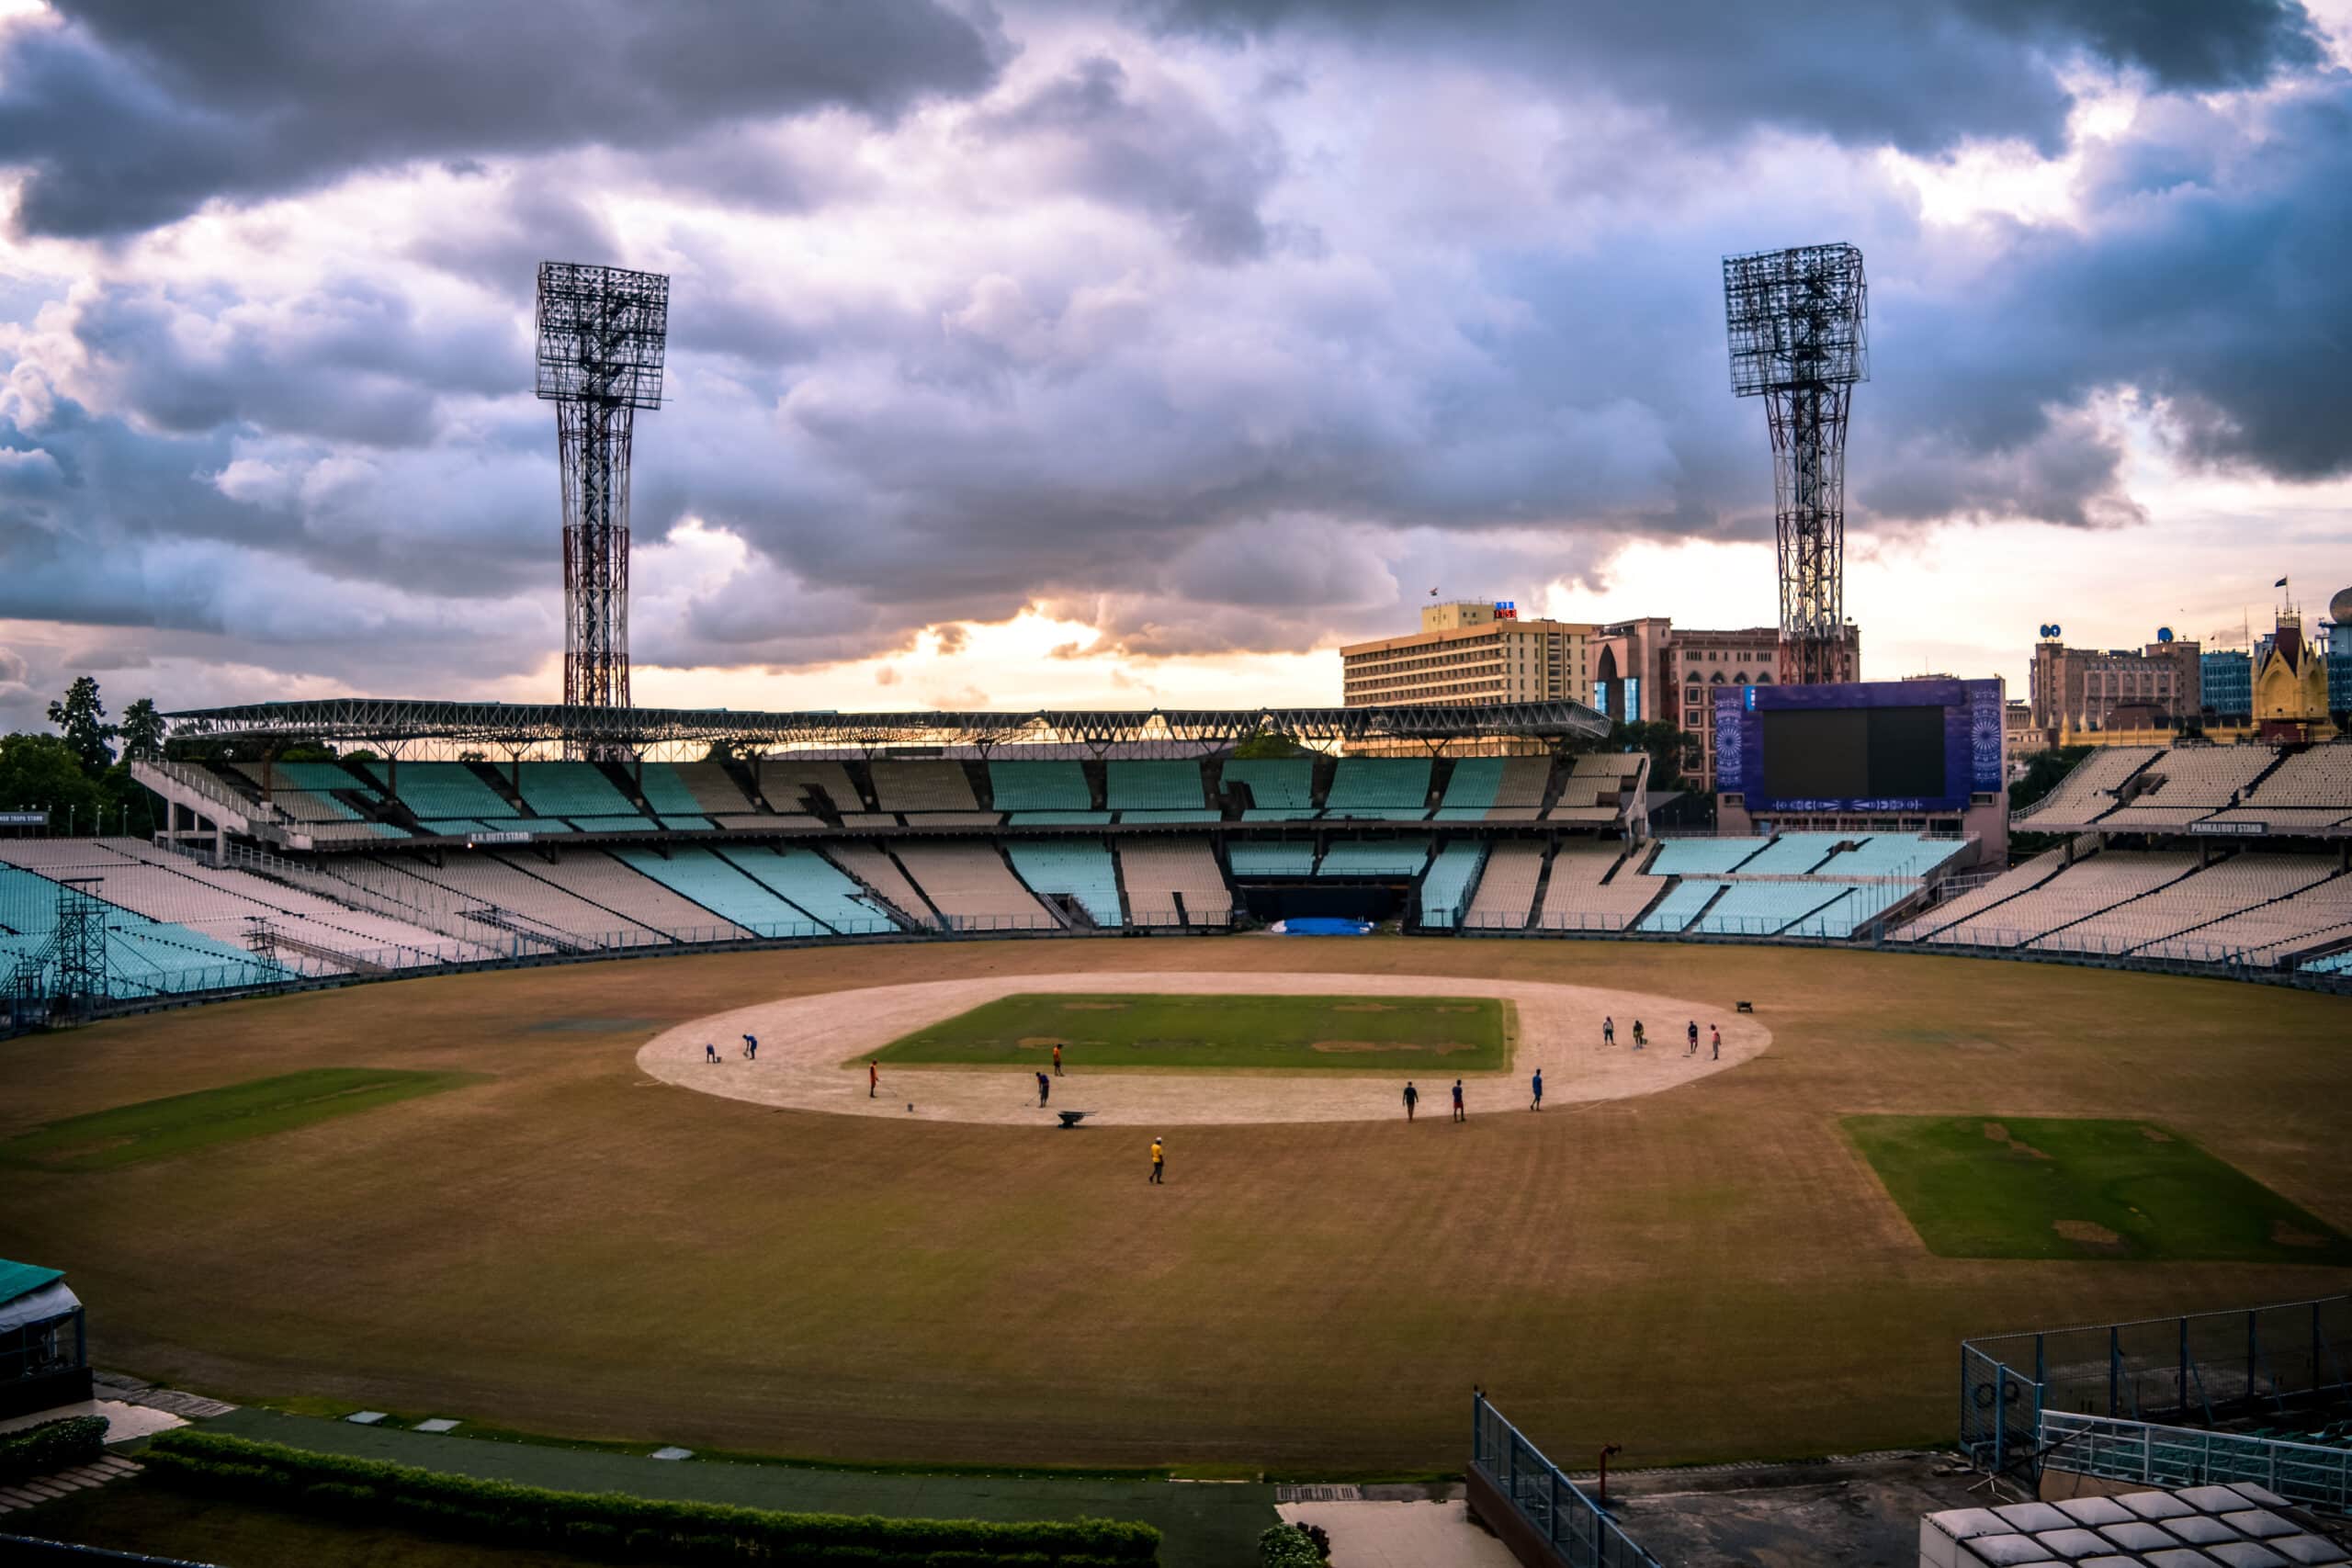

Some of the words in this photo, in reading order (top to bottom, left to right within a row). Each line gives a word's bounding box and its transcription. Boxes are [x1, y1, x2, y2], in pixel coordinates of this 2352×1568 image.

[2222, 823, 2236, 833] ROY
[2238, 823, 2262, 833] STAND
[505, 831, 529, 841] STAND
